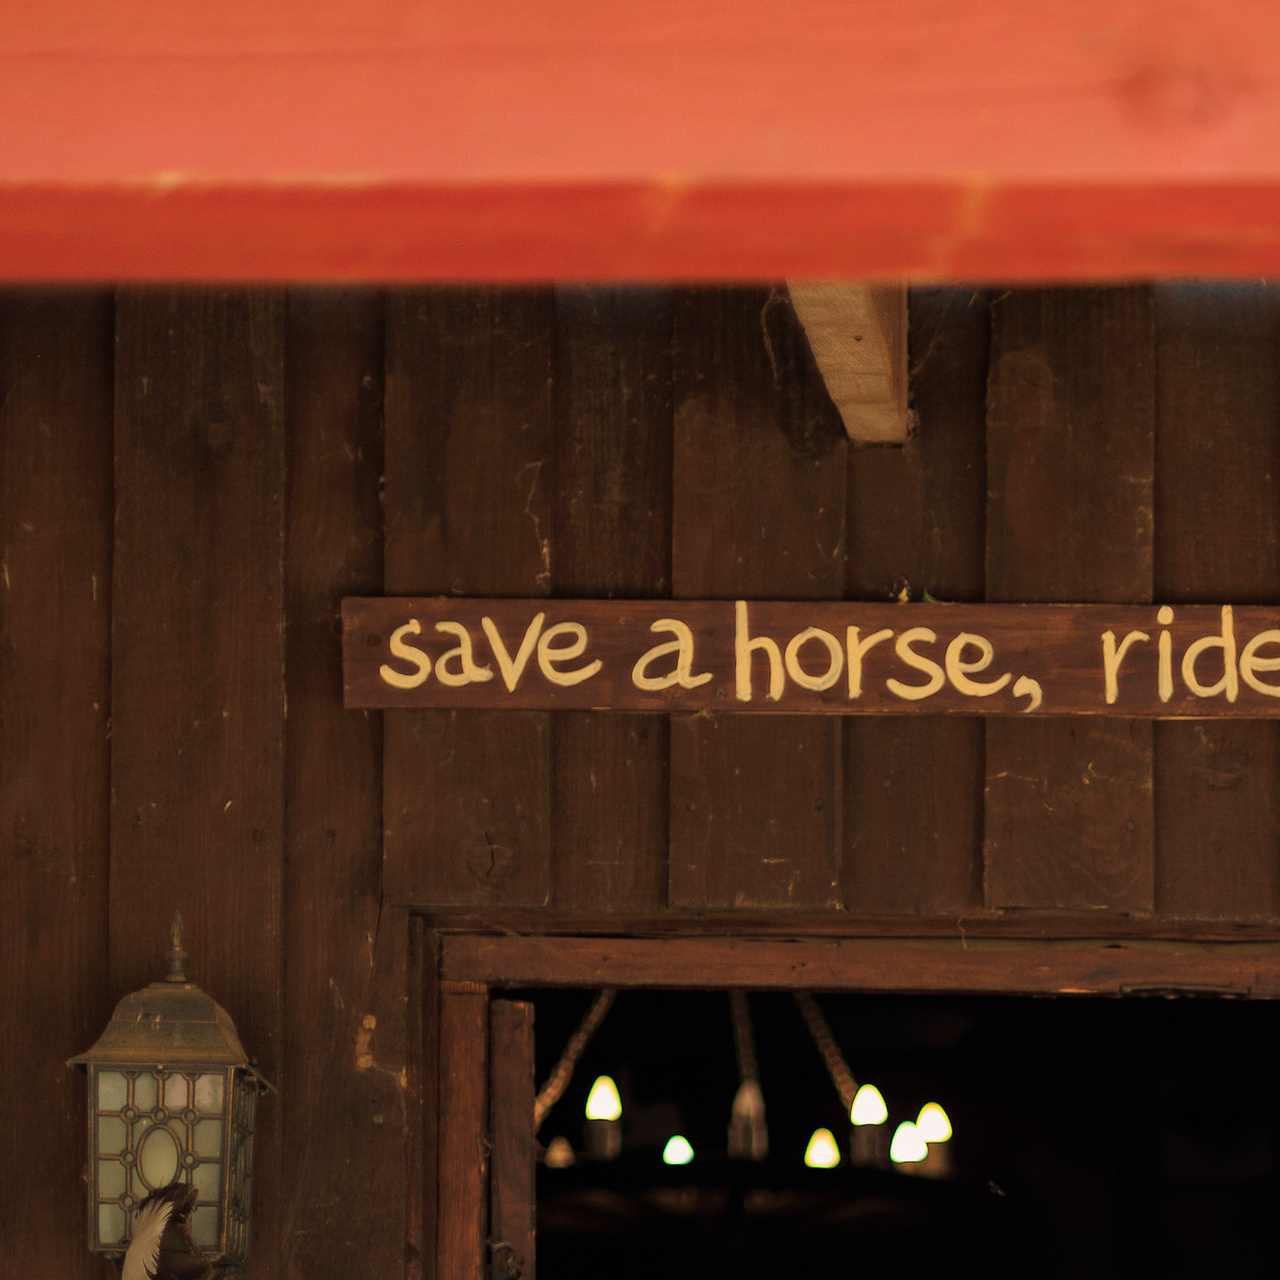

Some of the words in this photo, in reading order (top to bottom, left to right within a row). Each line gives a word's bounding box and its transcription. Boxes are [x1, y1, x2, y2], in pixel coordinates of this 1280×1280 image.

[379, 611, 603, 694] save
[631, 617, 713, 692] a
[734, 599, 1044, 714] horse,
